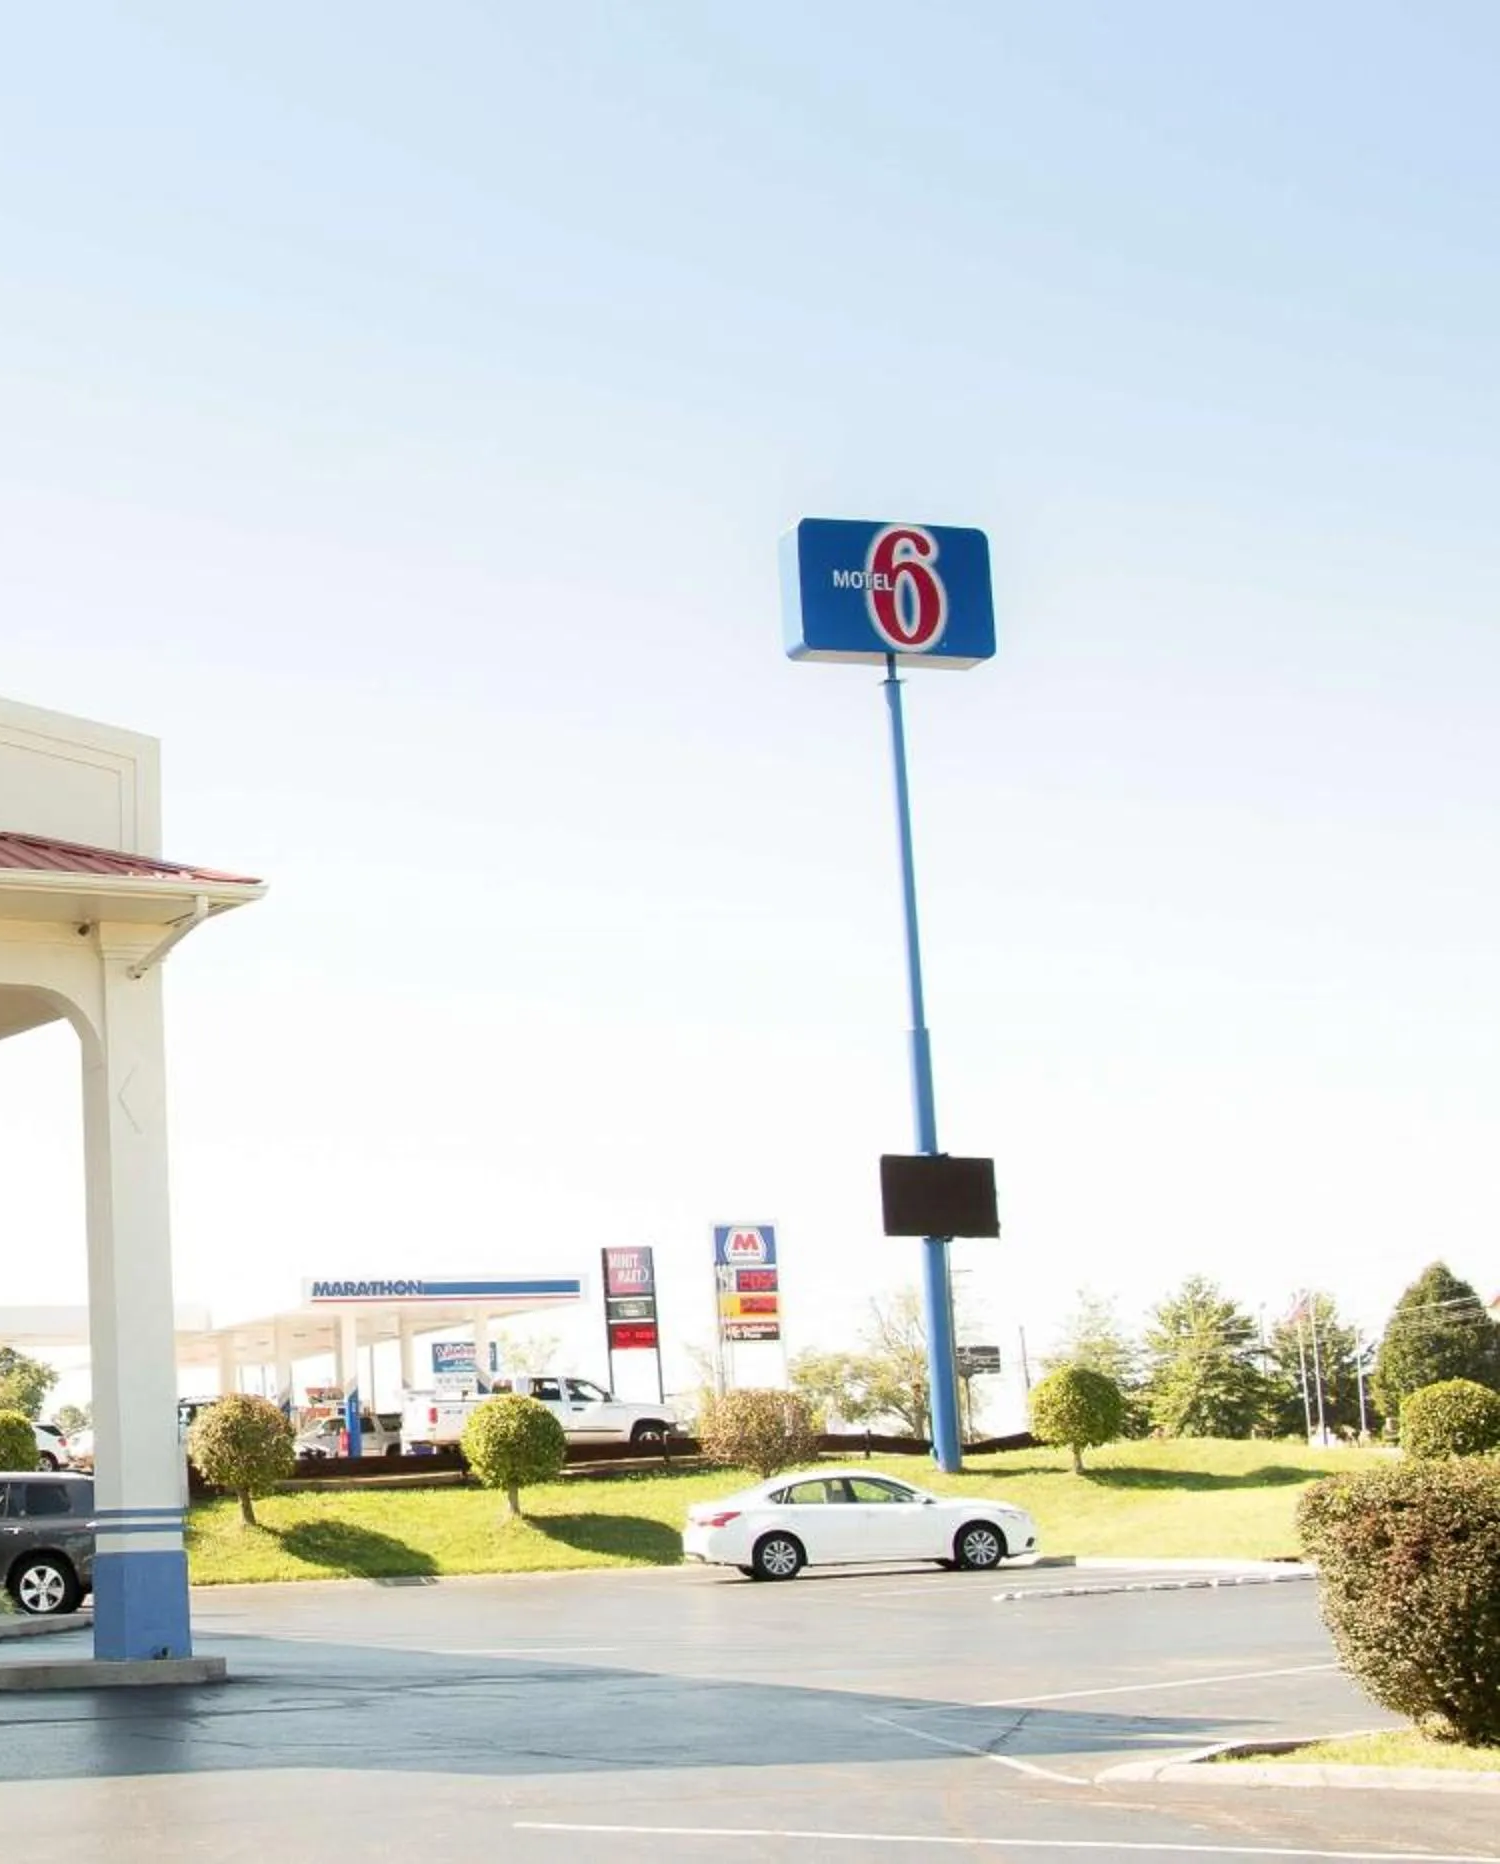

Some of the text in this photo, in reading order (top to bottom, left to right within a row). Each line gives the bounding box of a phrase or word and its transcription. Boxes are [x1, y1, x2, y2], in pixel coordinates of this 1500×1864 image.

[833, 528, 942, 647] MOTEL 6
[312, 1279, 423, 1297] MARATHON
